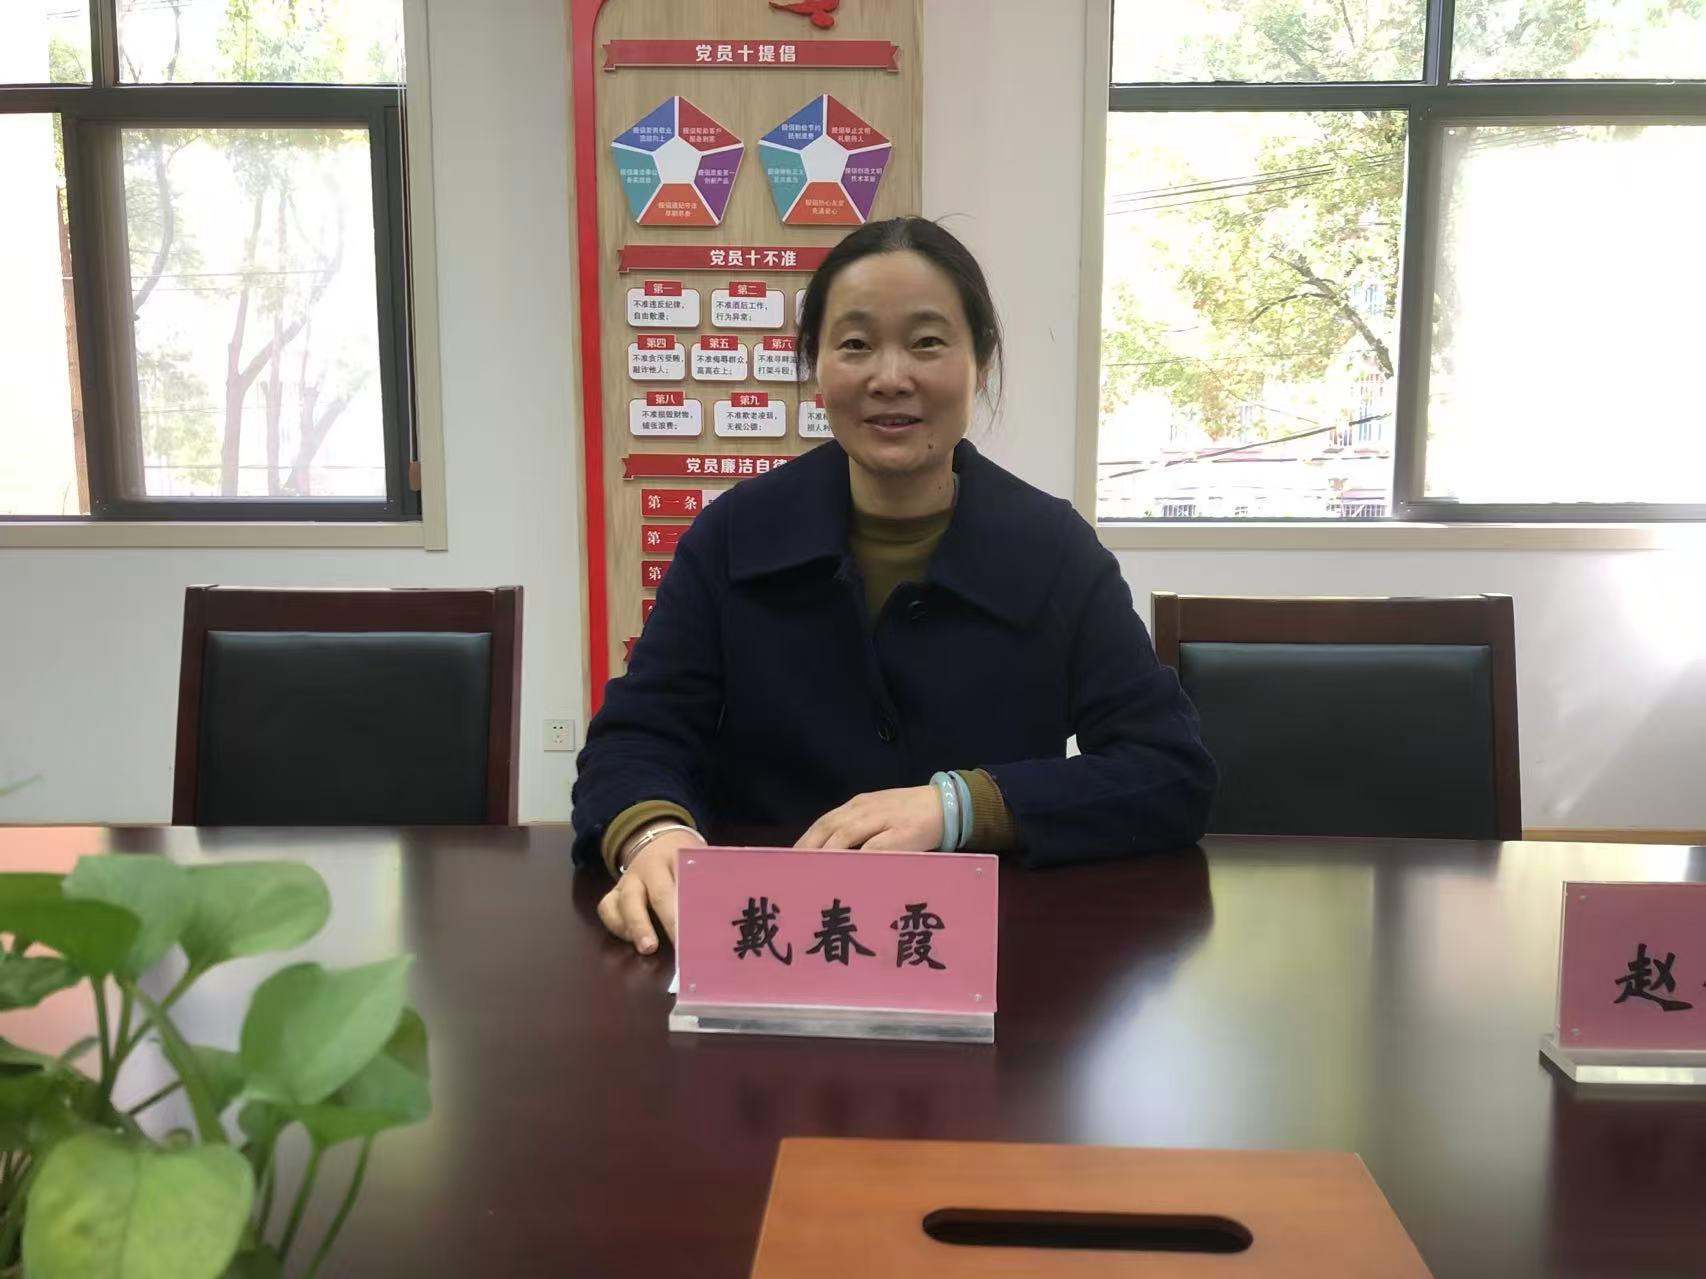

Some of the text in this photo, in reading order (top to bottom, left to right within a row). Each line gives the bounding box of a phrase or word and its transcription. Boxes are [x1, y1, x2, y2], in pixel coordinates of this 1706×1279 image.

[695, 44, 797, 63] 党员十提倡
[709, 250, 797, 267] 党员十不准
[653, 283, 673, 294] 第一
[737, 284, 758, 295] 第二
[646, 337, 667, 349] 第四
[709, 338, 729, 349] 第五
[771, 338, 792, 349] 第六
[655, 394, 676, 405] 第八
[739, 395, 761, 406] 第九
[647, 494, 697, 511] 第一条
[647, 530, 678, 546] 第二
[648, 566, 662, 581] 第
[732, 896, 947, 970] 戴春霞
[1613, 943, 1706, 1012] 赵
